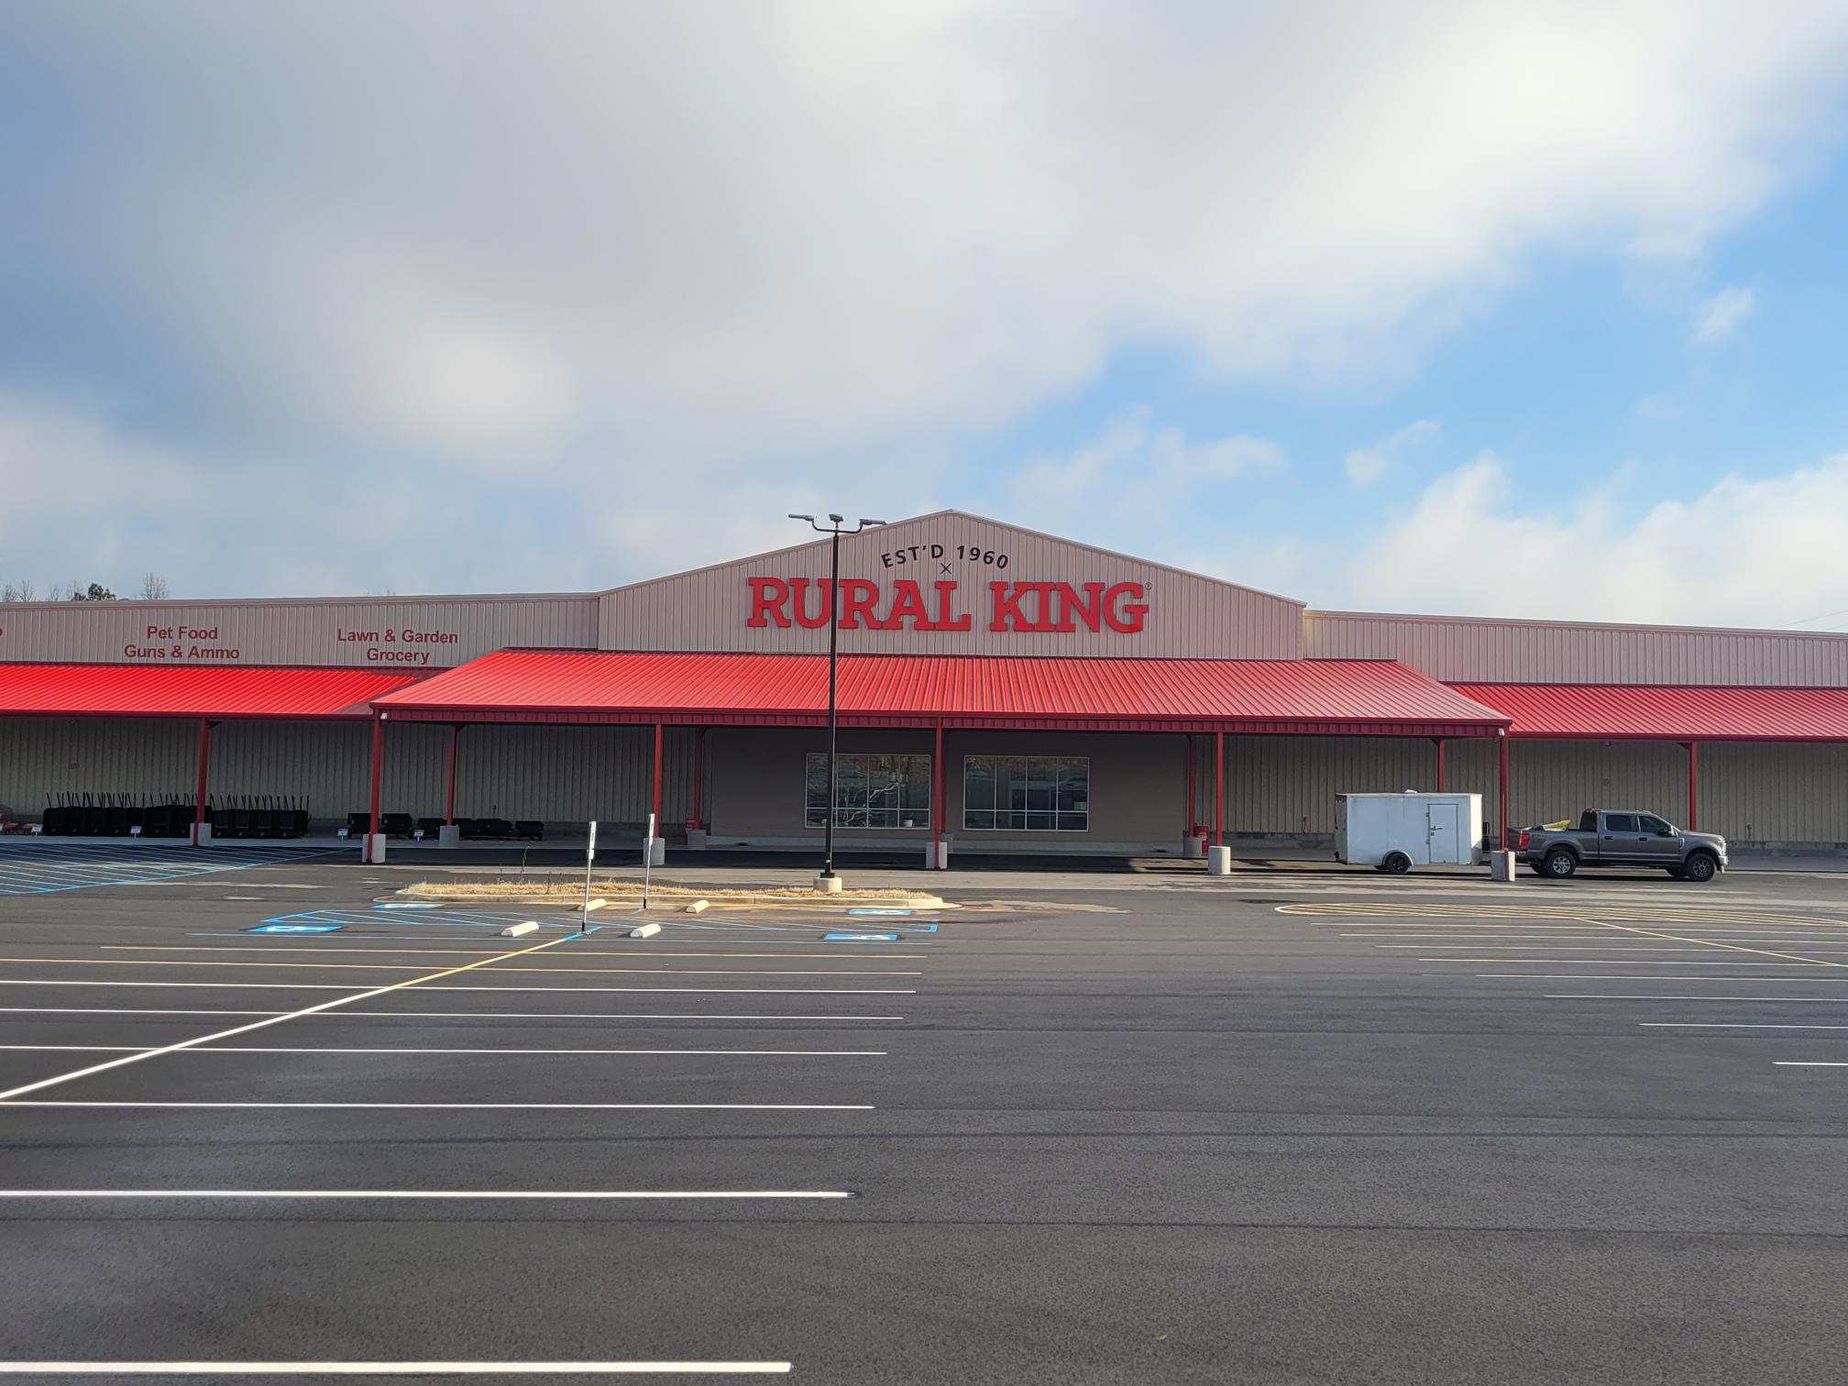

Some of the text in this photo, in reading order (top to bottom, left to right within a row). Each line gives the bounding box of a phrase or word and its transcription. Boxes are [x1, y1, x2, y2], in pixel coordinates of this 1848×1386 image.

[882, 544, 1009, 570] EST'D 1960
[746, 577, 1149, 633] RURAL KING
[147, 626, 219, 642] Pet Food
[337, 629, 458, 645] Lawn & Garden
[124, 644, 240, 660] Guns & Ammo
[366, 647, 430, 666] Grocery
